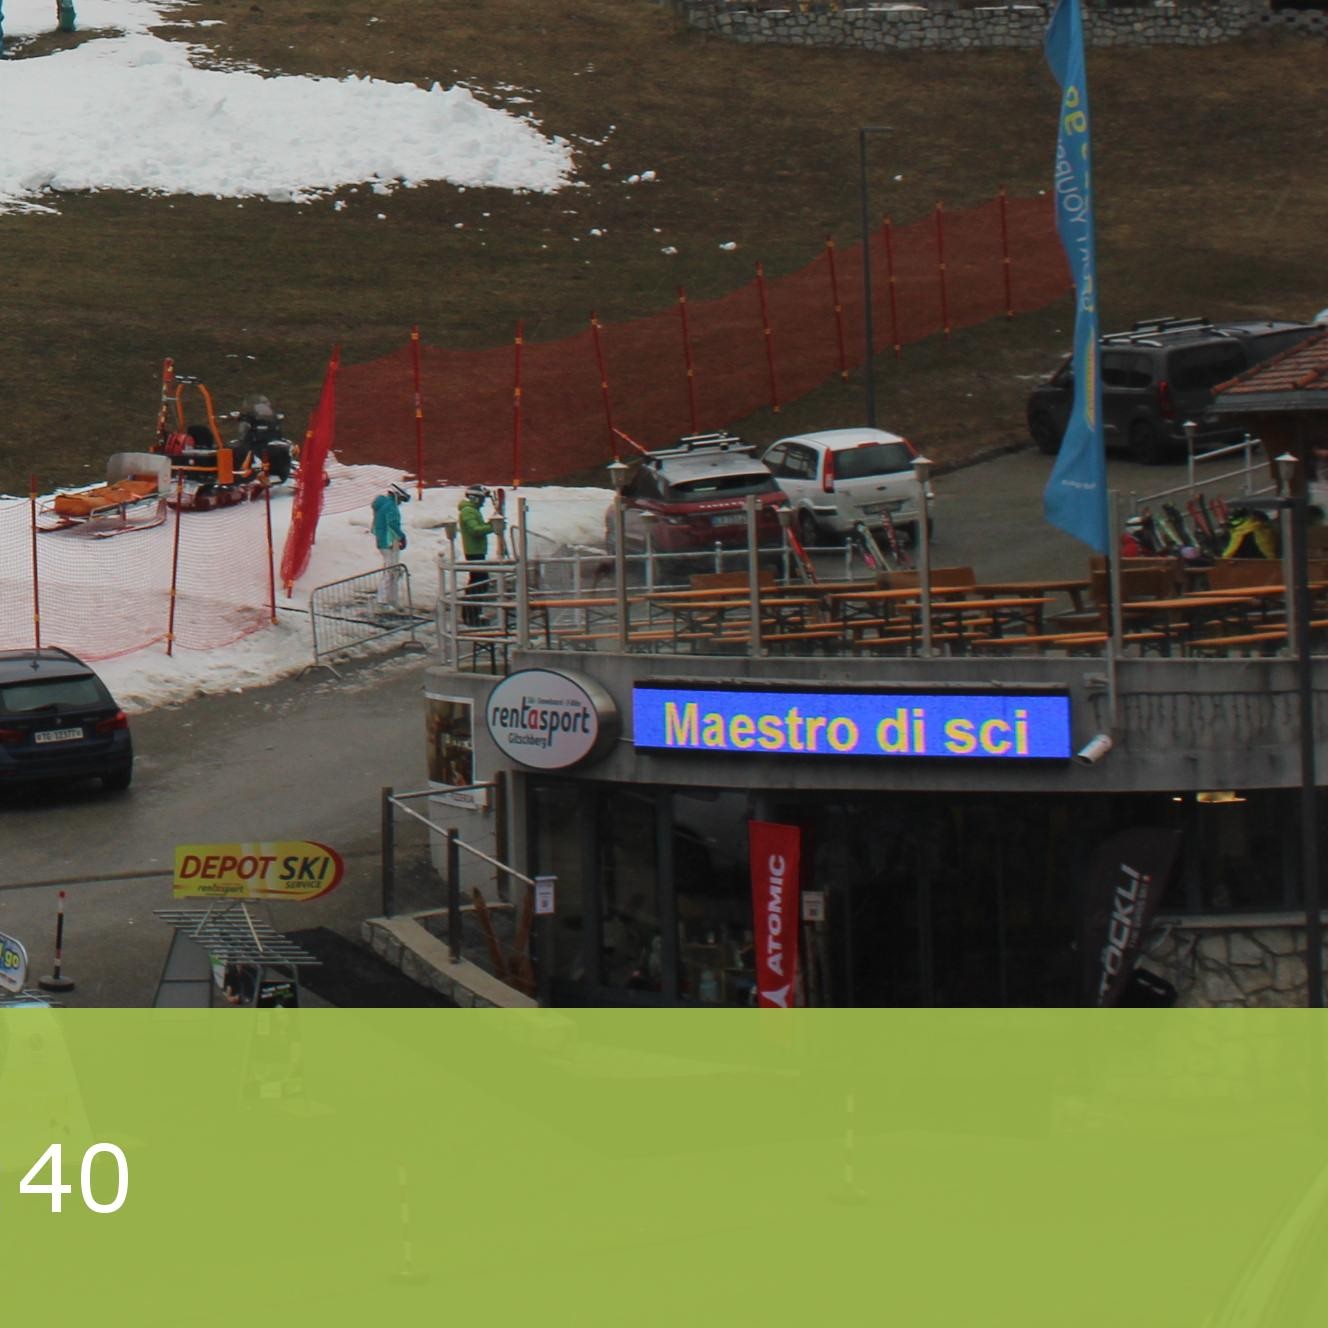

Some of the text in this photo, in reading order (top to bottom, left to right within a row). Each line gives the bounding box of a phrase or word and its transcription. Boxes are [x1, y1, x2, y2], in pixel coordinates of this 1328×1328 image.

[492, 696, 591, 747] rentasport
[664, 702, 1030, 755] Maestro di sci
[179, 855, 331, 880] DEPOT SKI
[285, 880, 322, 890] SERVICE
[767, 855, 786, 976] ATOMIC
[4, 950, 21, 969] go
